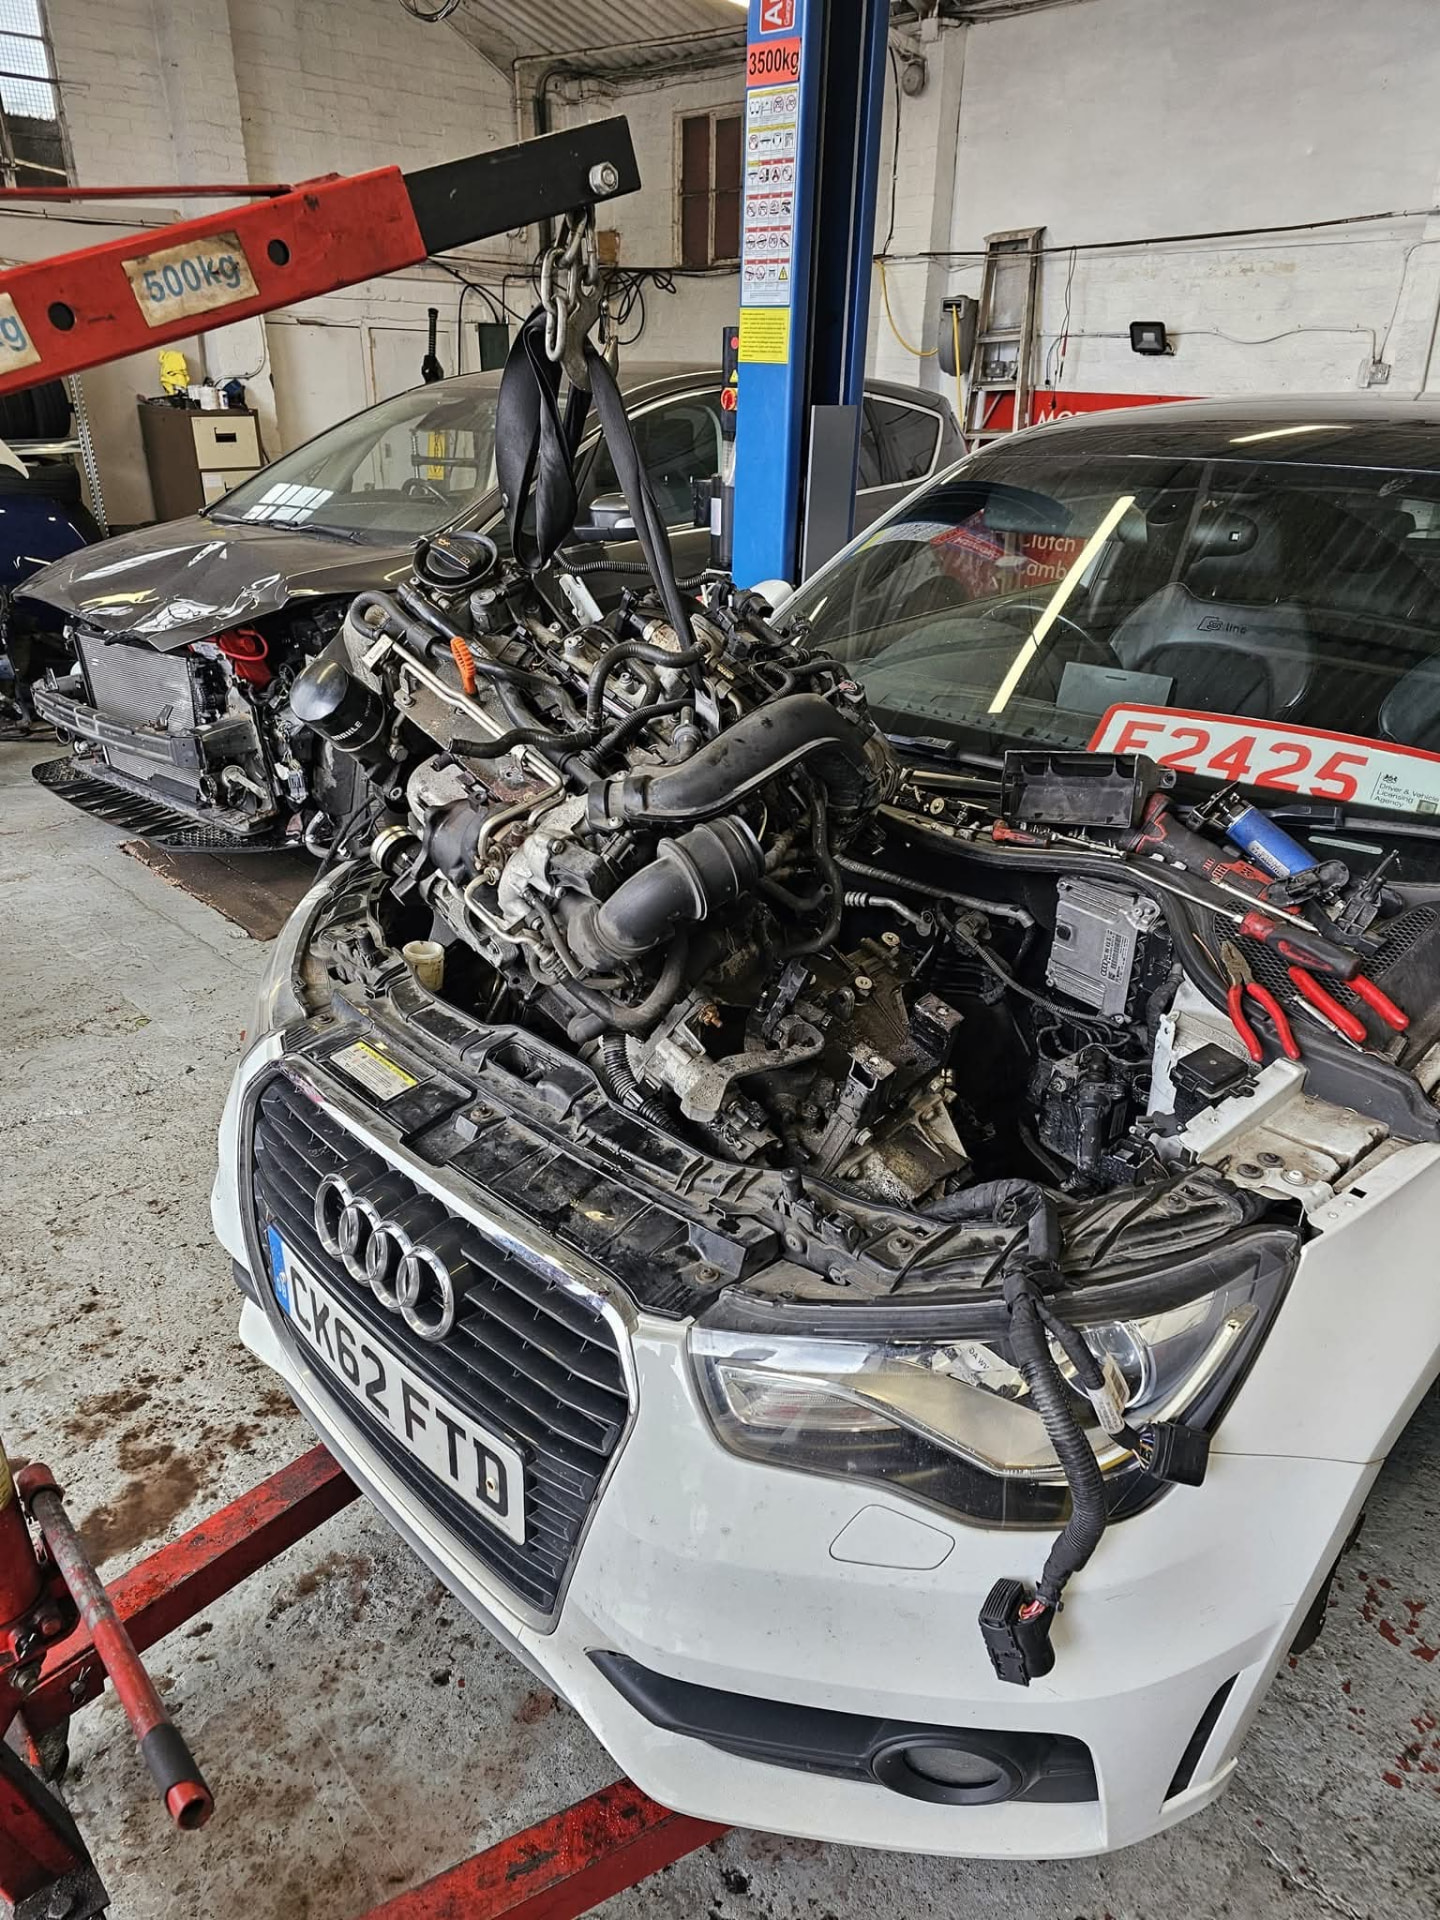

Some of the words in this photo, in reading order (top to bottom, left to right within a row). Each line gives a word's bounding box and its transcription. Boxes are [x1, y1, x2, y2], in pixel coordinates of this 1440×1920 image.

[749, 47, 800, 76] 3500kg
[144, 254, 241, 303] 500kg
[289, 1264, 390, 1420] CK62
[400, 1378, 509, 1518] FTD
